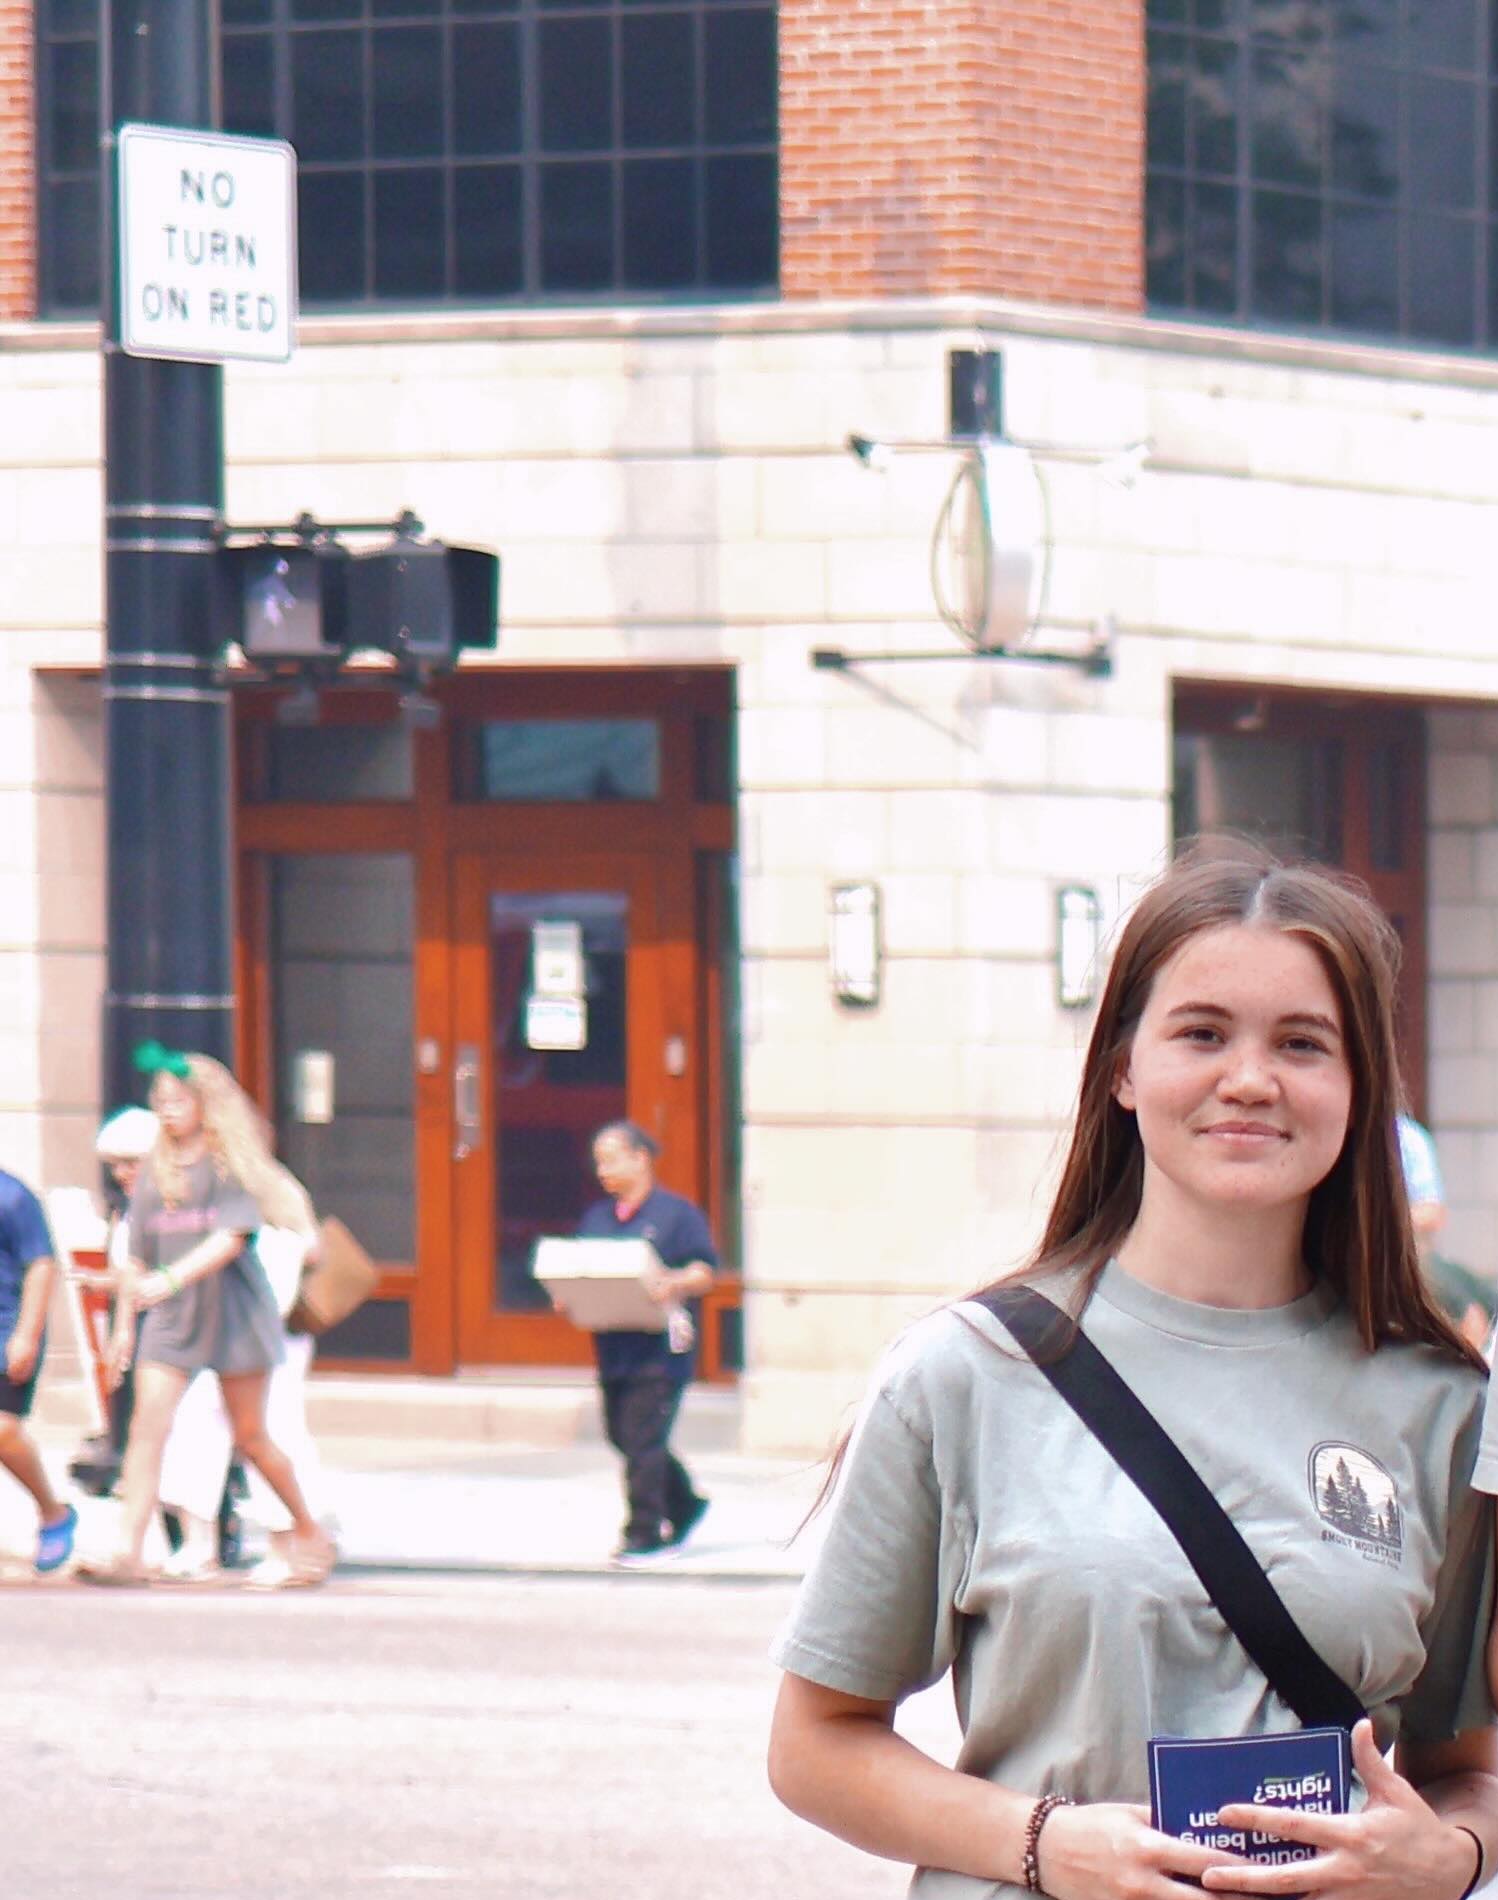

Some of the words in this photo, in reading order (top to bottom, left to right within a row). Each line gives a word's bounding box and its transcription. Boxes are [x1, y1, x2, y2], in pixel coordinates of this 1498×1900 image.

[180, 168, 236, 209] NO
[162, 223, 257, 270] TURN
[141, 282, 190, 323] ON
[209, 287, 277, 333] RED
[1253, 1776, 1331, 1803] rights?
